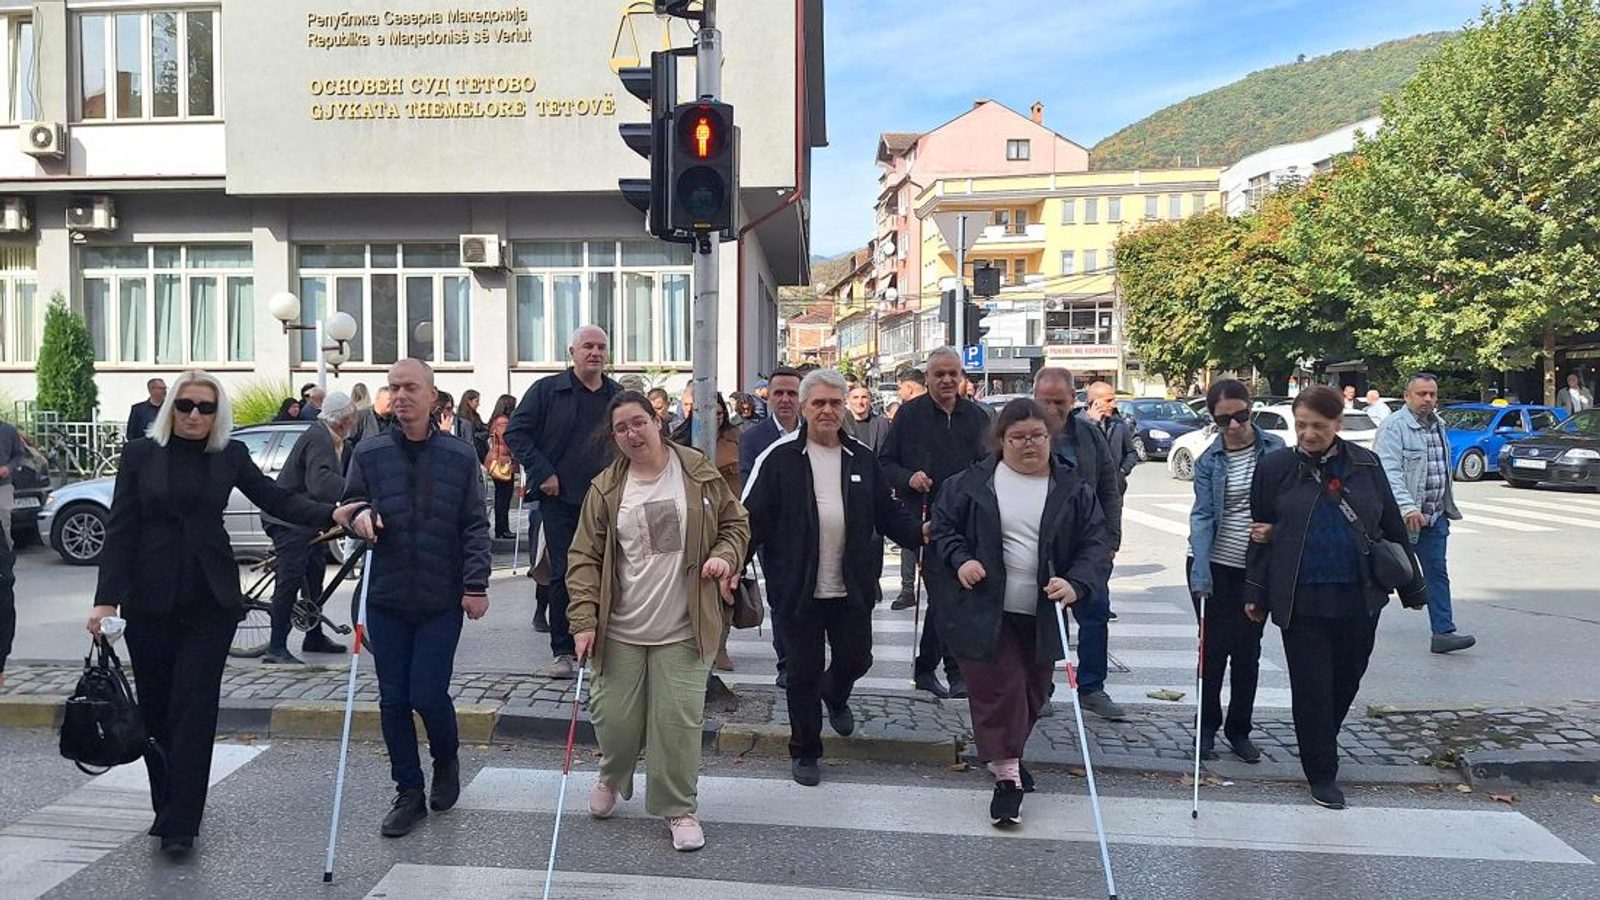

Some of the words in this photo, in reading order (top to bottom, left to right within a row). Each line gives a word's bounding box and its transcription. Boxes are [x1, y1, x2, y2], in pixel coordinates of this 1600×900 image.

[307, 12, 379, 30] Република
[384, 11, 443, 28] Северна
[447, 7, 528, 25] Македонија
[308, 32, 370, 50] Republika
[376, 34, 385, 46] e
[389, 29, 469, 48] Maqedonisë
[473, 29, 490, 43] së
[495, 28, 532, 43] Veriut
[310, 77, 404, 96] ОСНОВЕН
[409, 76, 451, 96] СУД
[455, 74, 537, 94] ТЕТОВО
[310, 101, 401, 120] GJYKATA
[405, 99, 527, 119] THEMELORE
[535, 93, 616, 117] TETOVË
[968, 346, 979, 361] P
